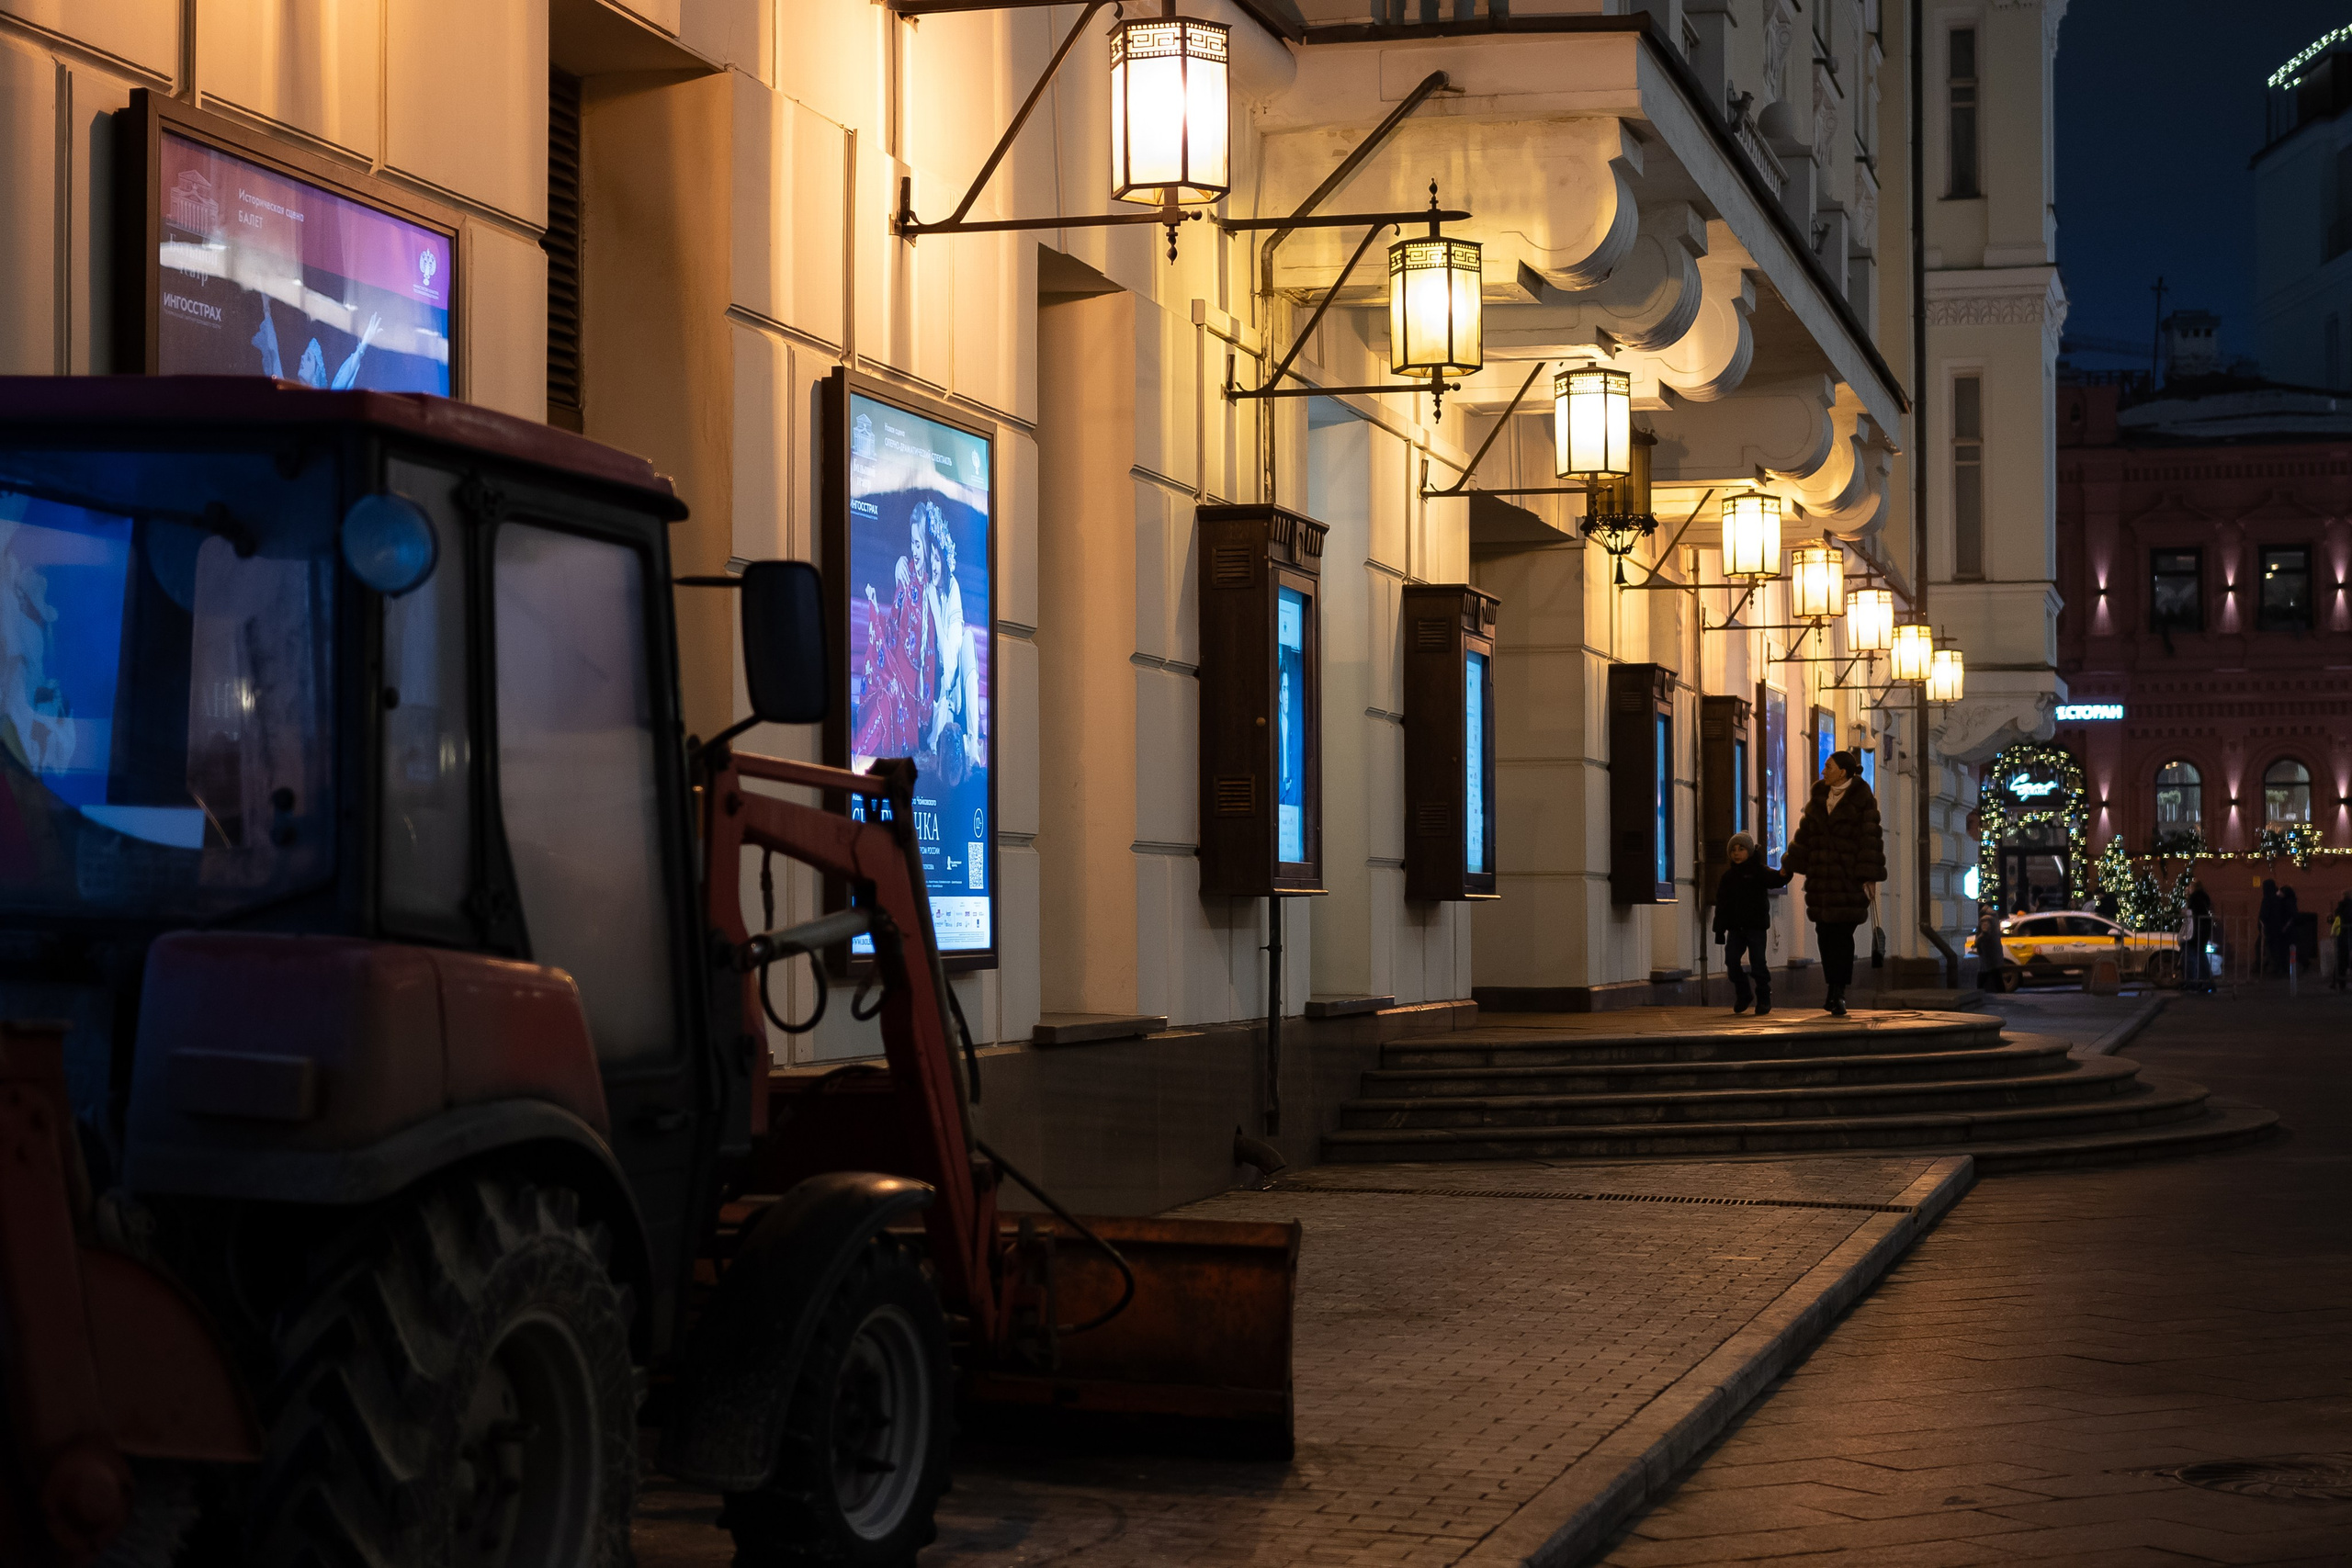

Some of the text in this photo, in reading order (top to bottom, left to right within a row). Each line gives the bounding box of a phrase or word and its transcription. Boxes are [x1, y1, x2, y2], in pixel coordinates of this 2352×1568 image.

[238, 187, 304, 222] Историческая сцена
[238, 209, 263, 230] БАЛЕТ
[164, 291, 222, 322] ИНГОССТРАХ
[2055, 705, 2124, 720] ЕСТОРАН
